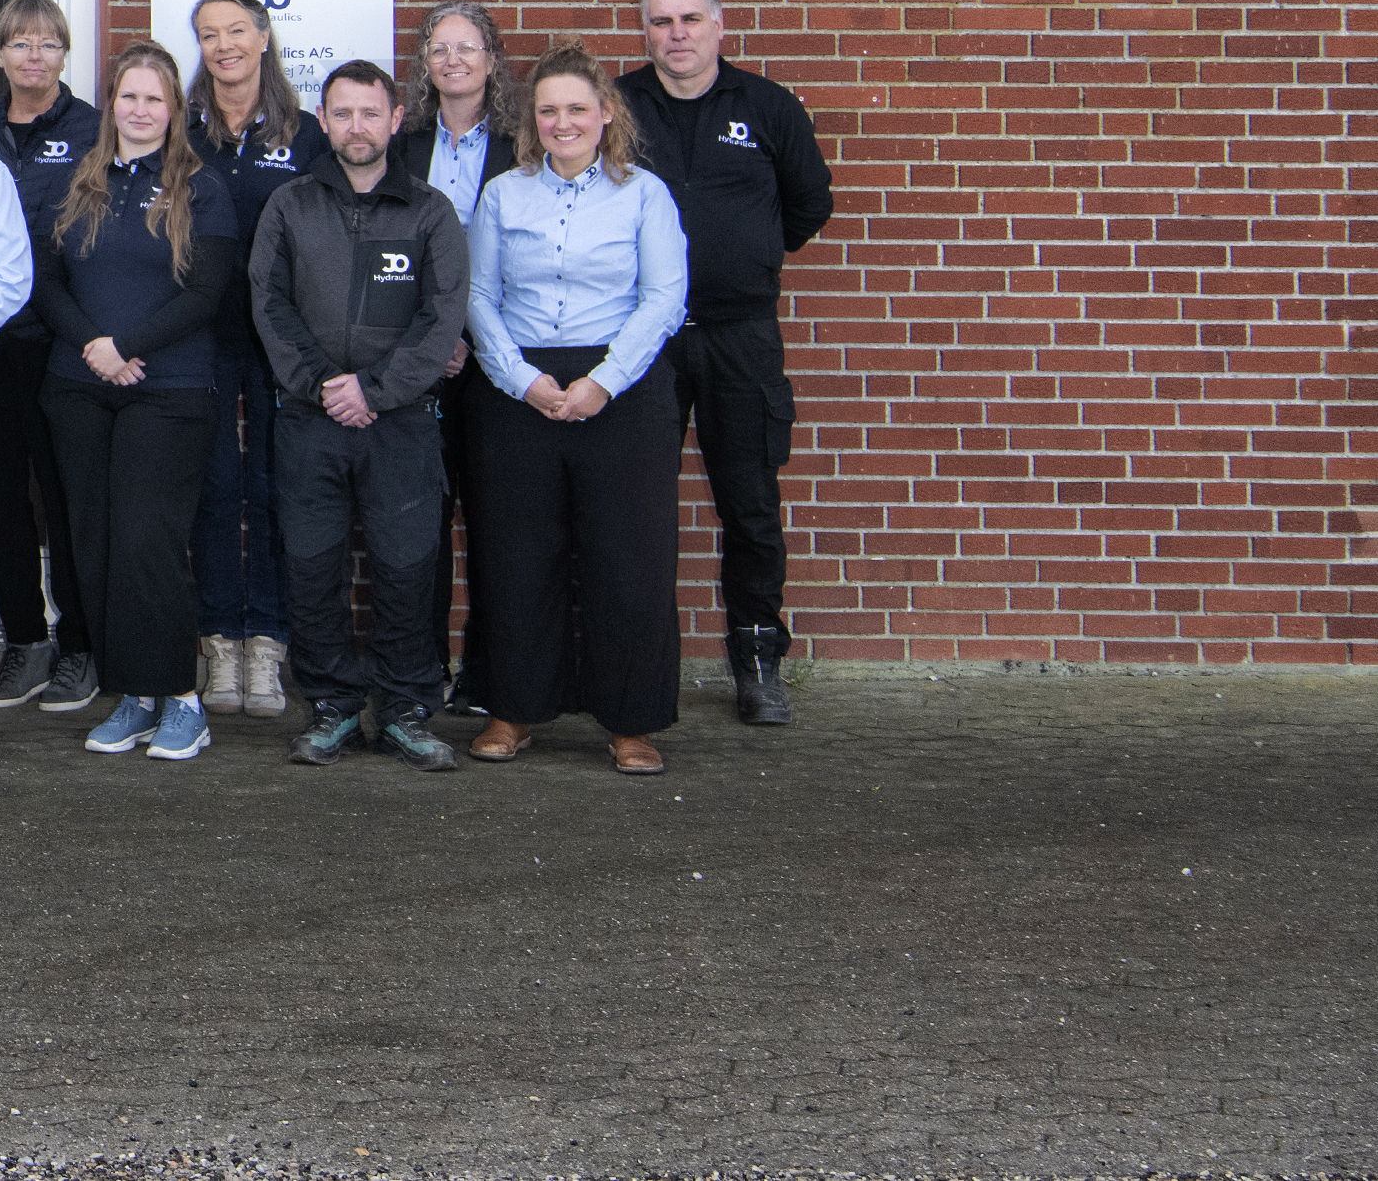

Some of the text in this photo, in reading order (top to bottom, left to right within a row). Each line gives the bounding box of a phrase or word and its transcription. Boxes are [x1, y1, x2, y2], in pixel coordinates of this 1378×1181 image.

[309, 46, 334, 59] A/S
[298, 64, 314, 76] 74
[42, 140, 70, 157] JO
[254, 160, 297, 172] Hydraulics
[381, 253, 411, 273] JO
[374, 274, 415, 283] Hydraulics
